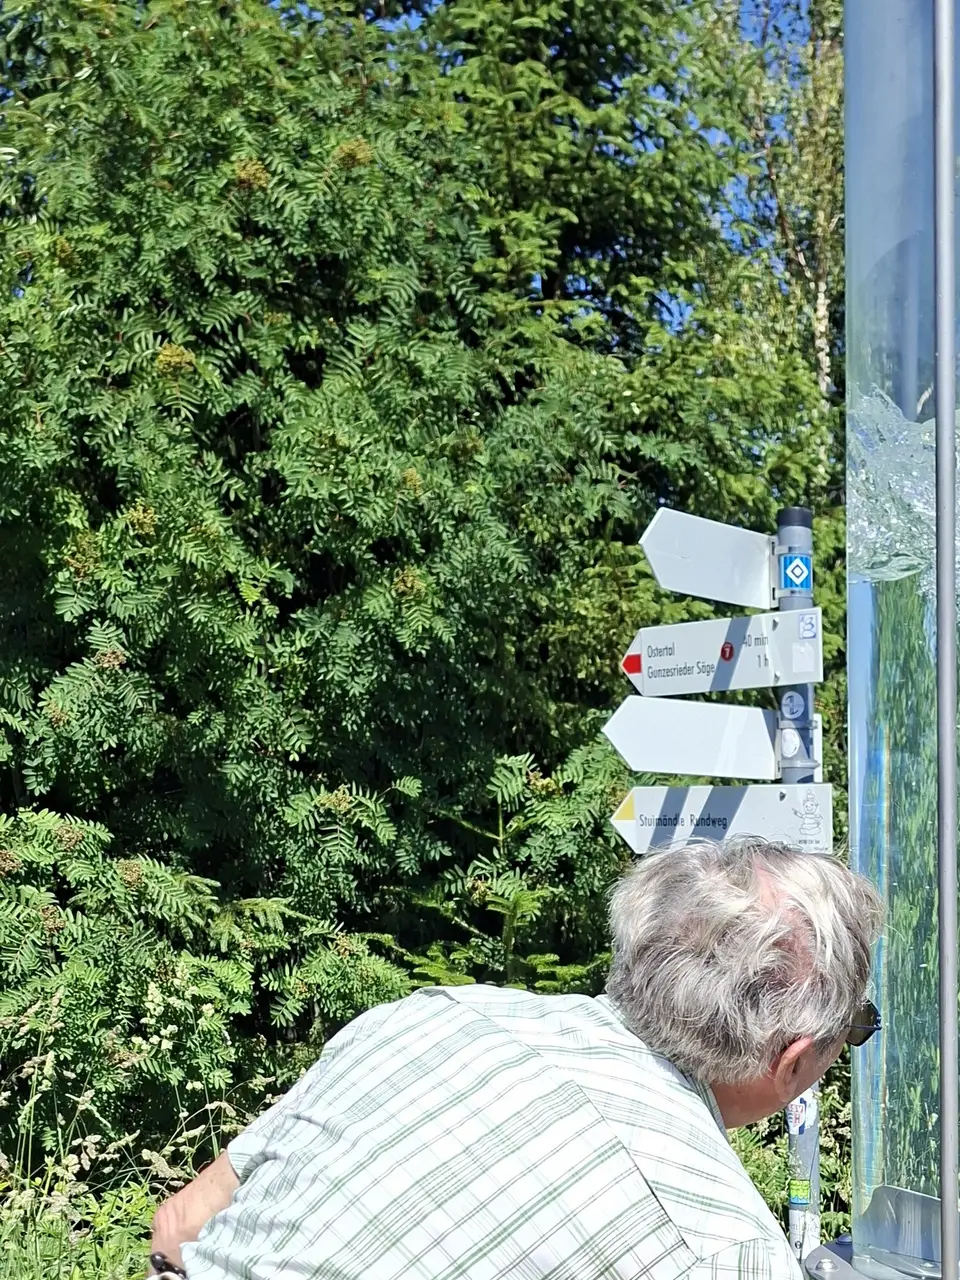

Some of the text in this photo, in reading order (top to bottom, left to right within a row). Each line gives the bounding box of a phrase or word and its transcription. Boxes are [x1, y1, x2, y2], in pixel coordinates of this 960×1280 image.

[754, 633, 769, 646] min
[647, 662, 695, 679] Gunzesrieder
[689, 812, 728, 830] Rundweg
